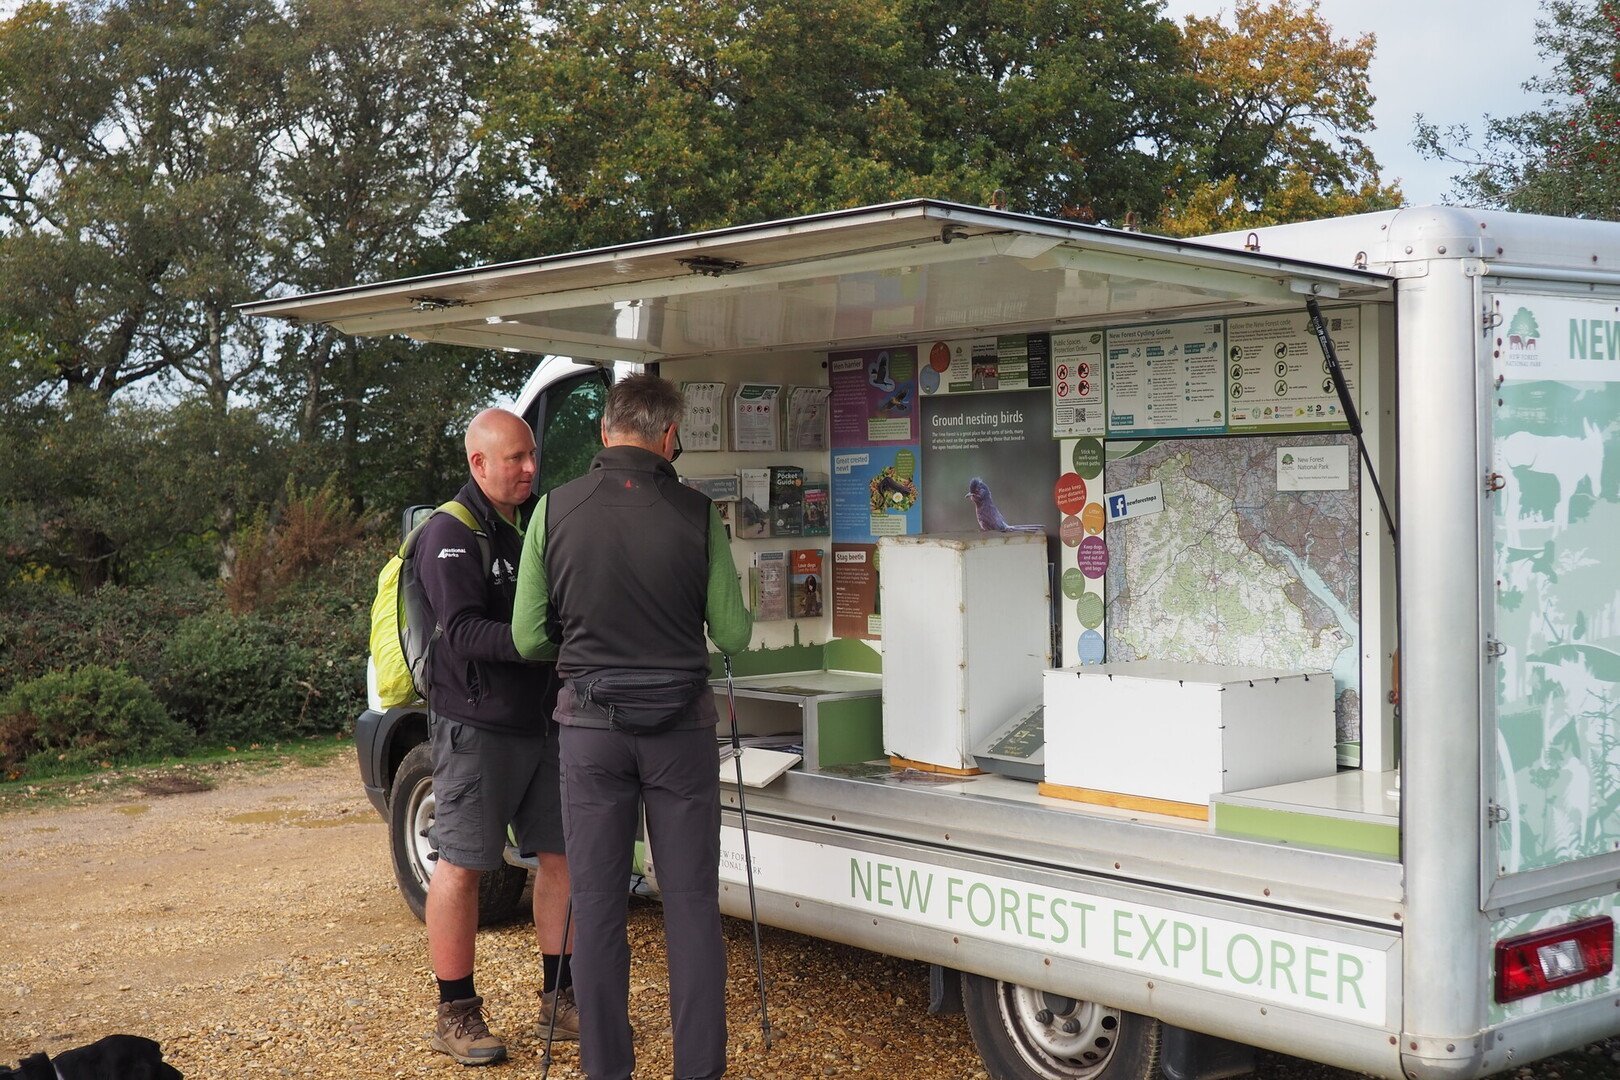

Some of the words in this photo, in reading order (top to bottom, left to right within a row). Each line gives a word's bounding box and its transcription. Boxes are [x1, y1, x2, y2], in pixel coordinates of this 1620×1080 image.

[1137, 329, 1155, 338] Cycling
[932, 413, 964, 426] Ground
[966, 412, 998, 428] nesting
[1000, 410, 1024, 424] birds
[850, 456, 868, 464] crested
[836, 553, 848, 562] Stag
[848, 552, 865, 561] beetle
[851, 857, 934, 914] NEW
[946, 876, 1096, 949] FOREST
[1112, 909, 1367, 1009] EXPLORER
